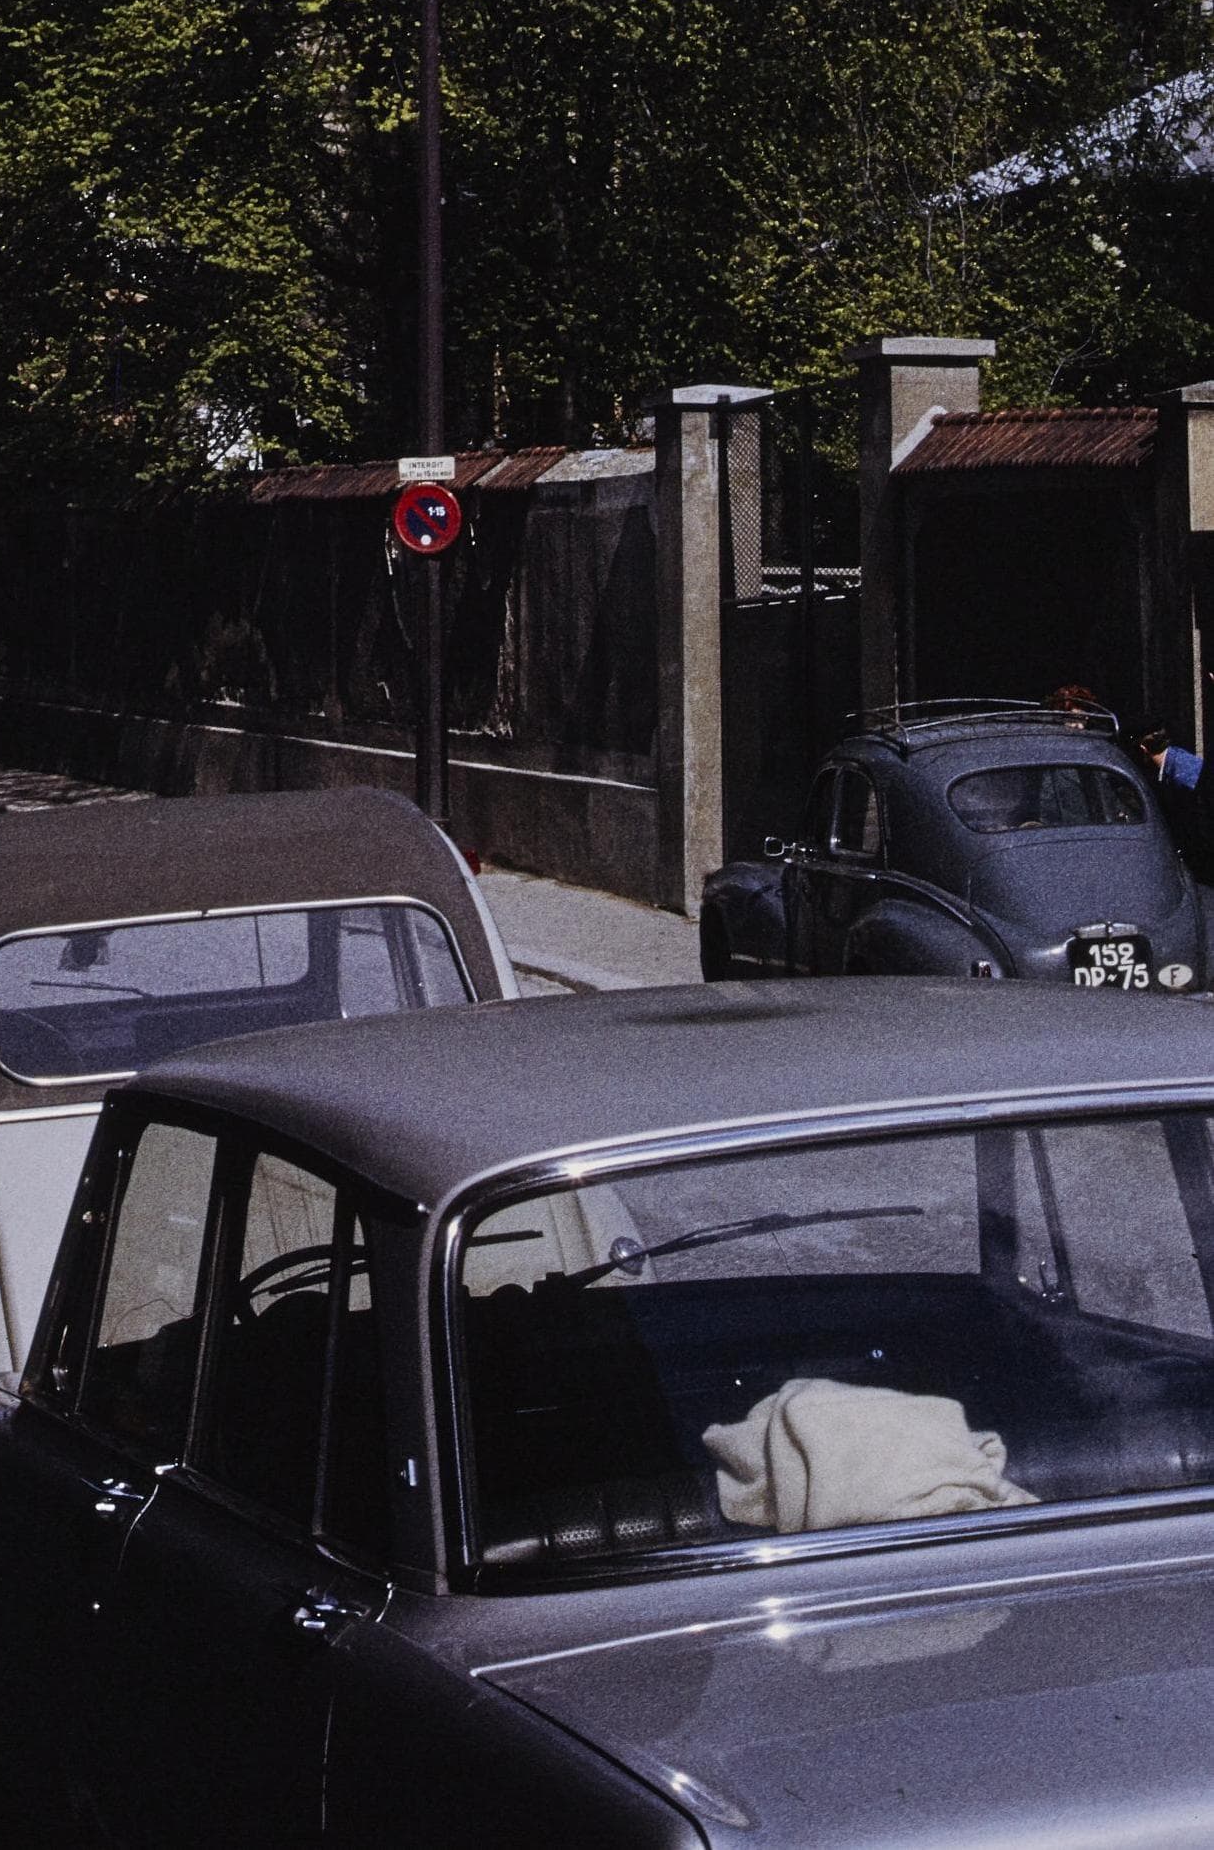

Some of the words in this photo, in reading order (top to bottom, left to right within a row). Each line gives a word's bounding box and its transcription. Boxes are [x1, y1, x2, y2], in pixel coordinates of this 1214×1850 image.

[408, 461, 444, 469] INTERDIT
[1089, 942, 1135, 967] 152
[1170, 966, 1181, 986] F
